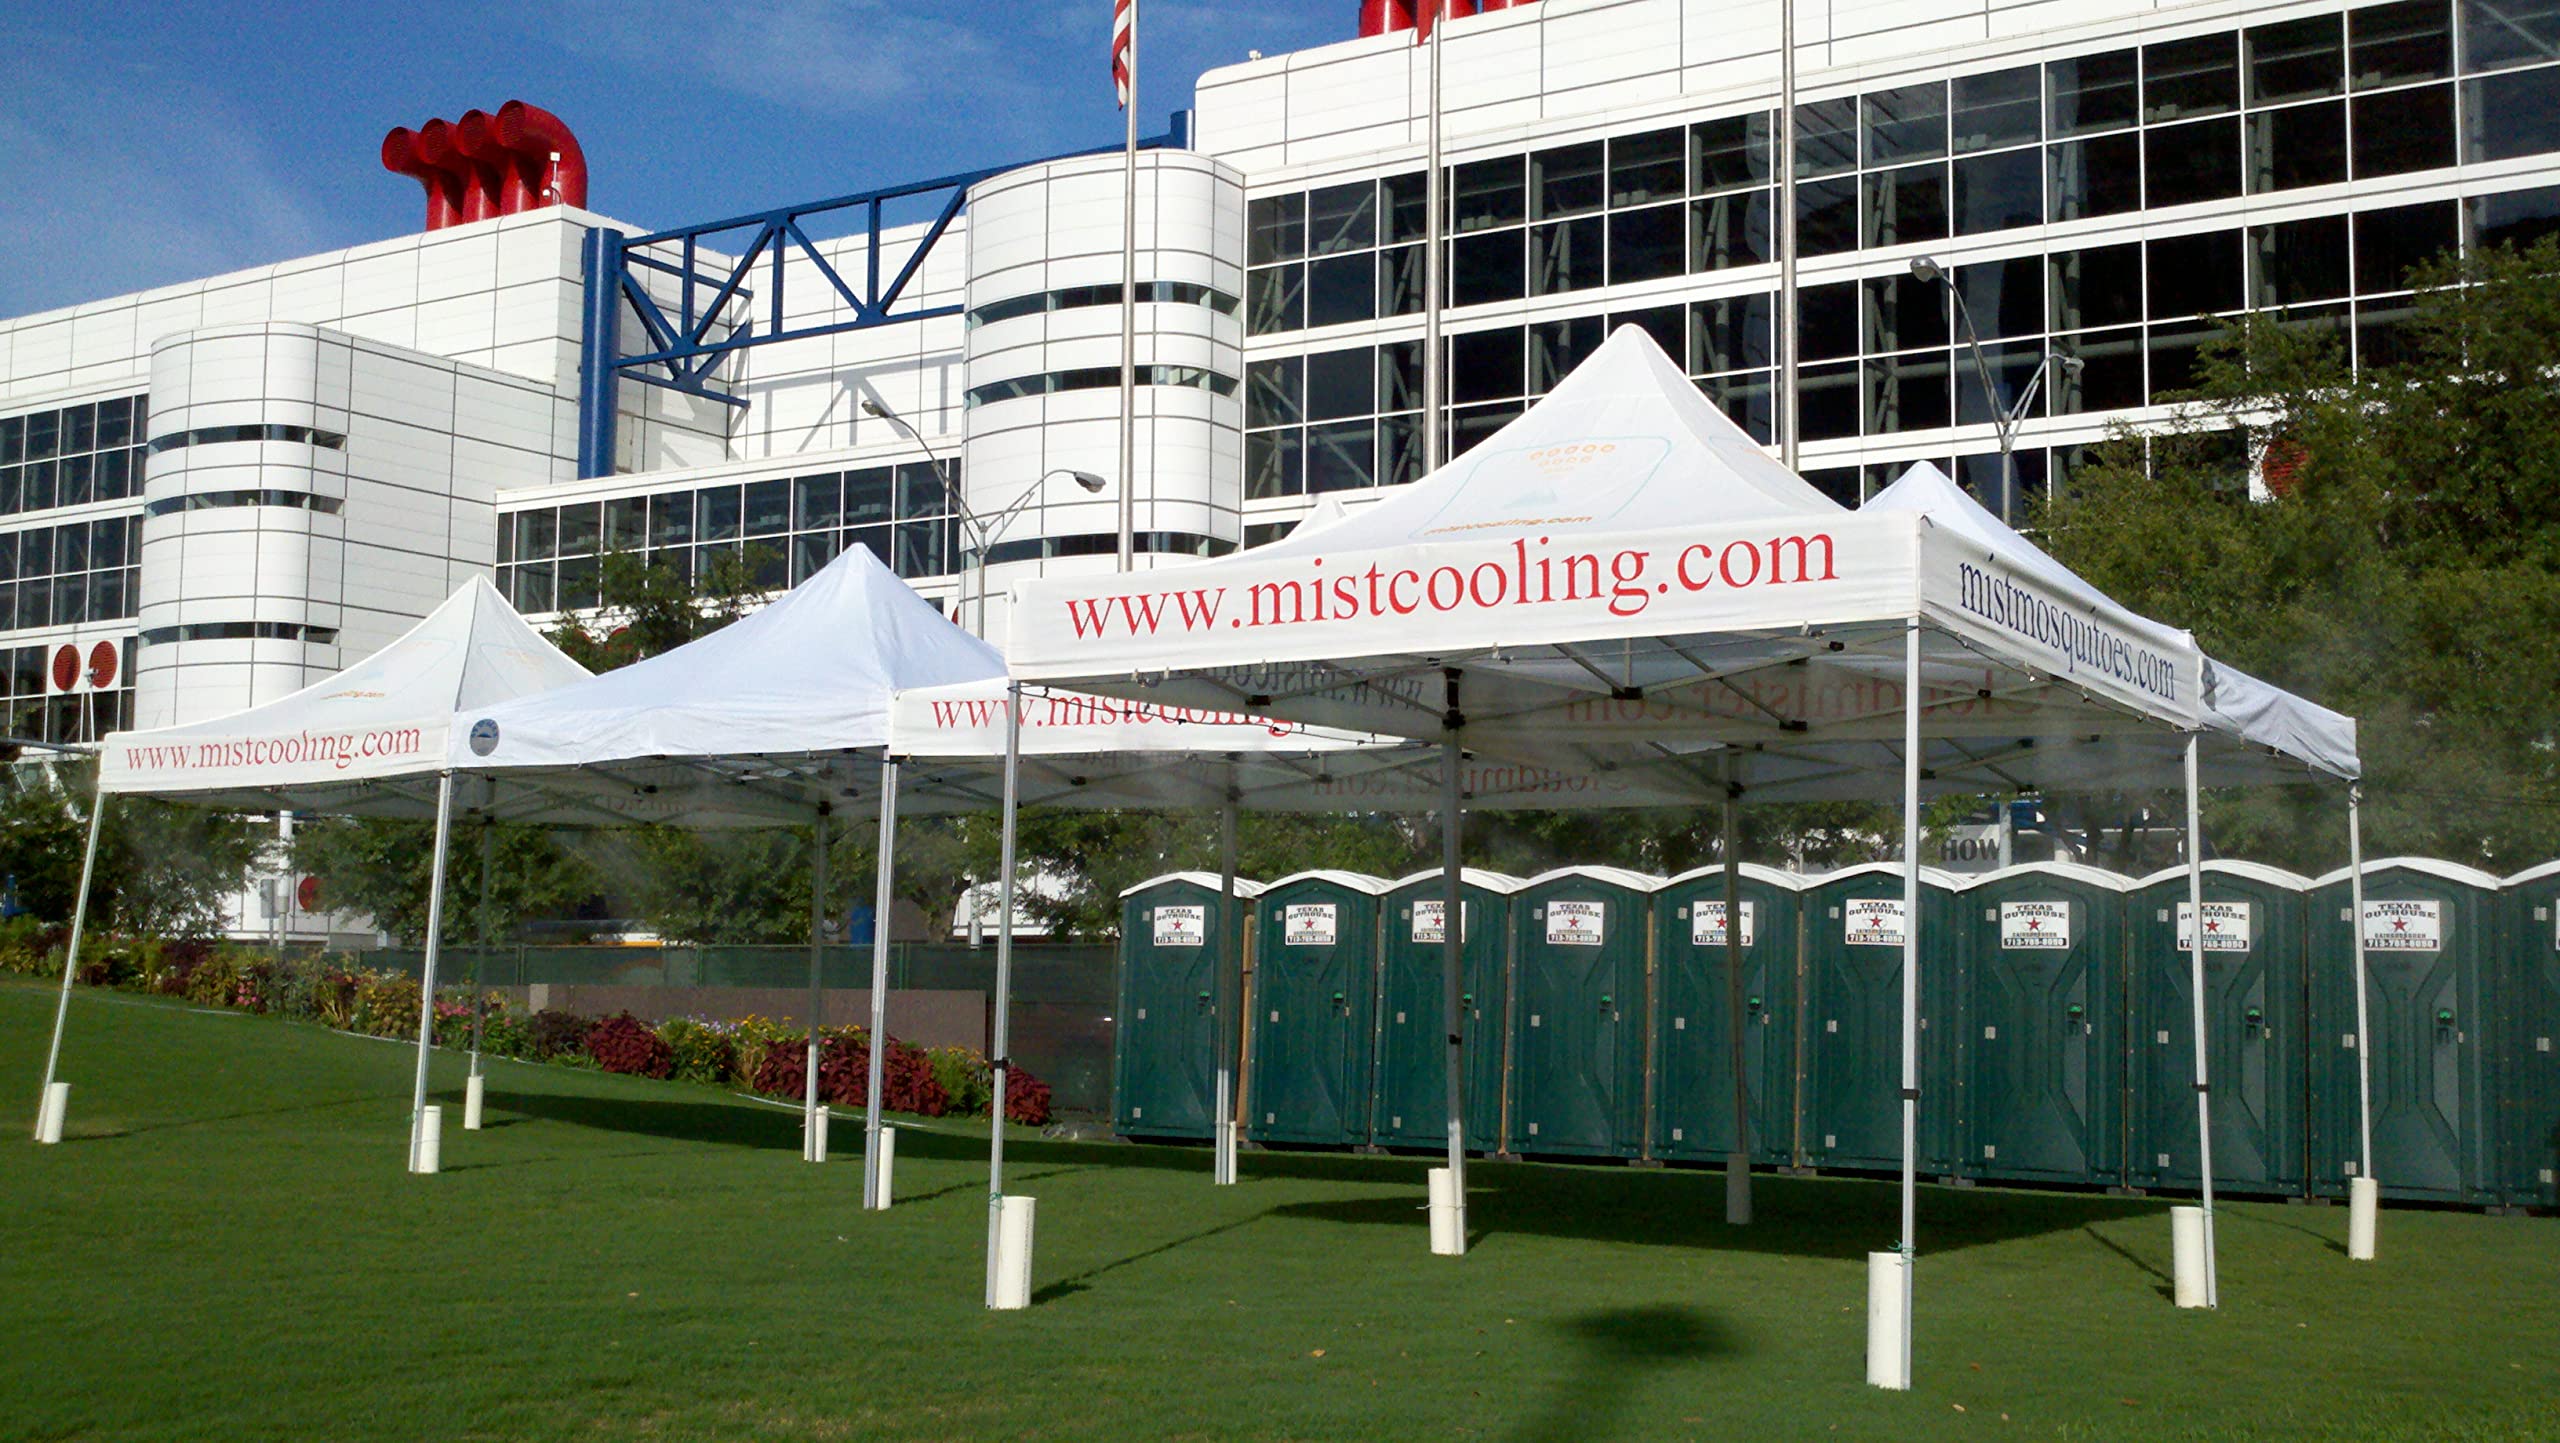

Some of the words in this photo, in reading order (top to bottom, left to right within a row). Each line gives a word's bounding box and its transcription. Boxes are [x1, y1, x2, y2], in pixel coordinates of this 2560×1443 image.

[1065, 533, 1840, 640] www.mistcooling.com
[1959, 553, 2175, 701] mistmosquitoes.com
[126, 727, 421, 770] www.mistcooling.com
[1859, 902, 1895, 910] TEXAS
[2201, 904, 2233, 912] EXAS
[2378, 903, 2422, 911] TEXAS
[2004, 910, 2066, 920] OUTHOUSE
[2180, 911, 2247, 920] OUHOUSE
[2364, 909, 2437, 919] OUTHOUSE
